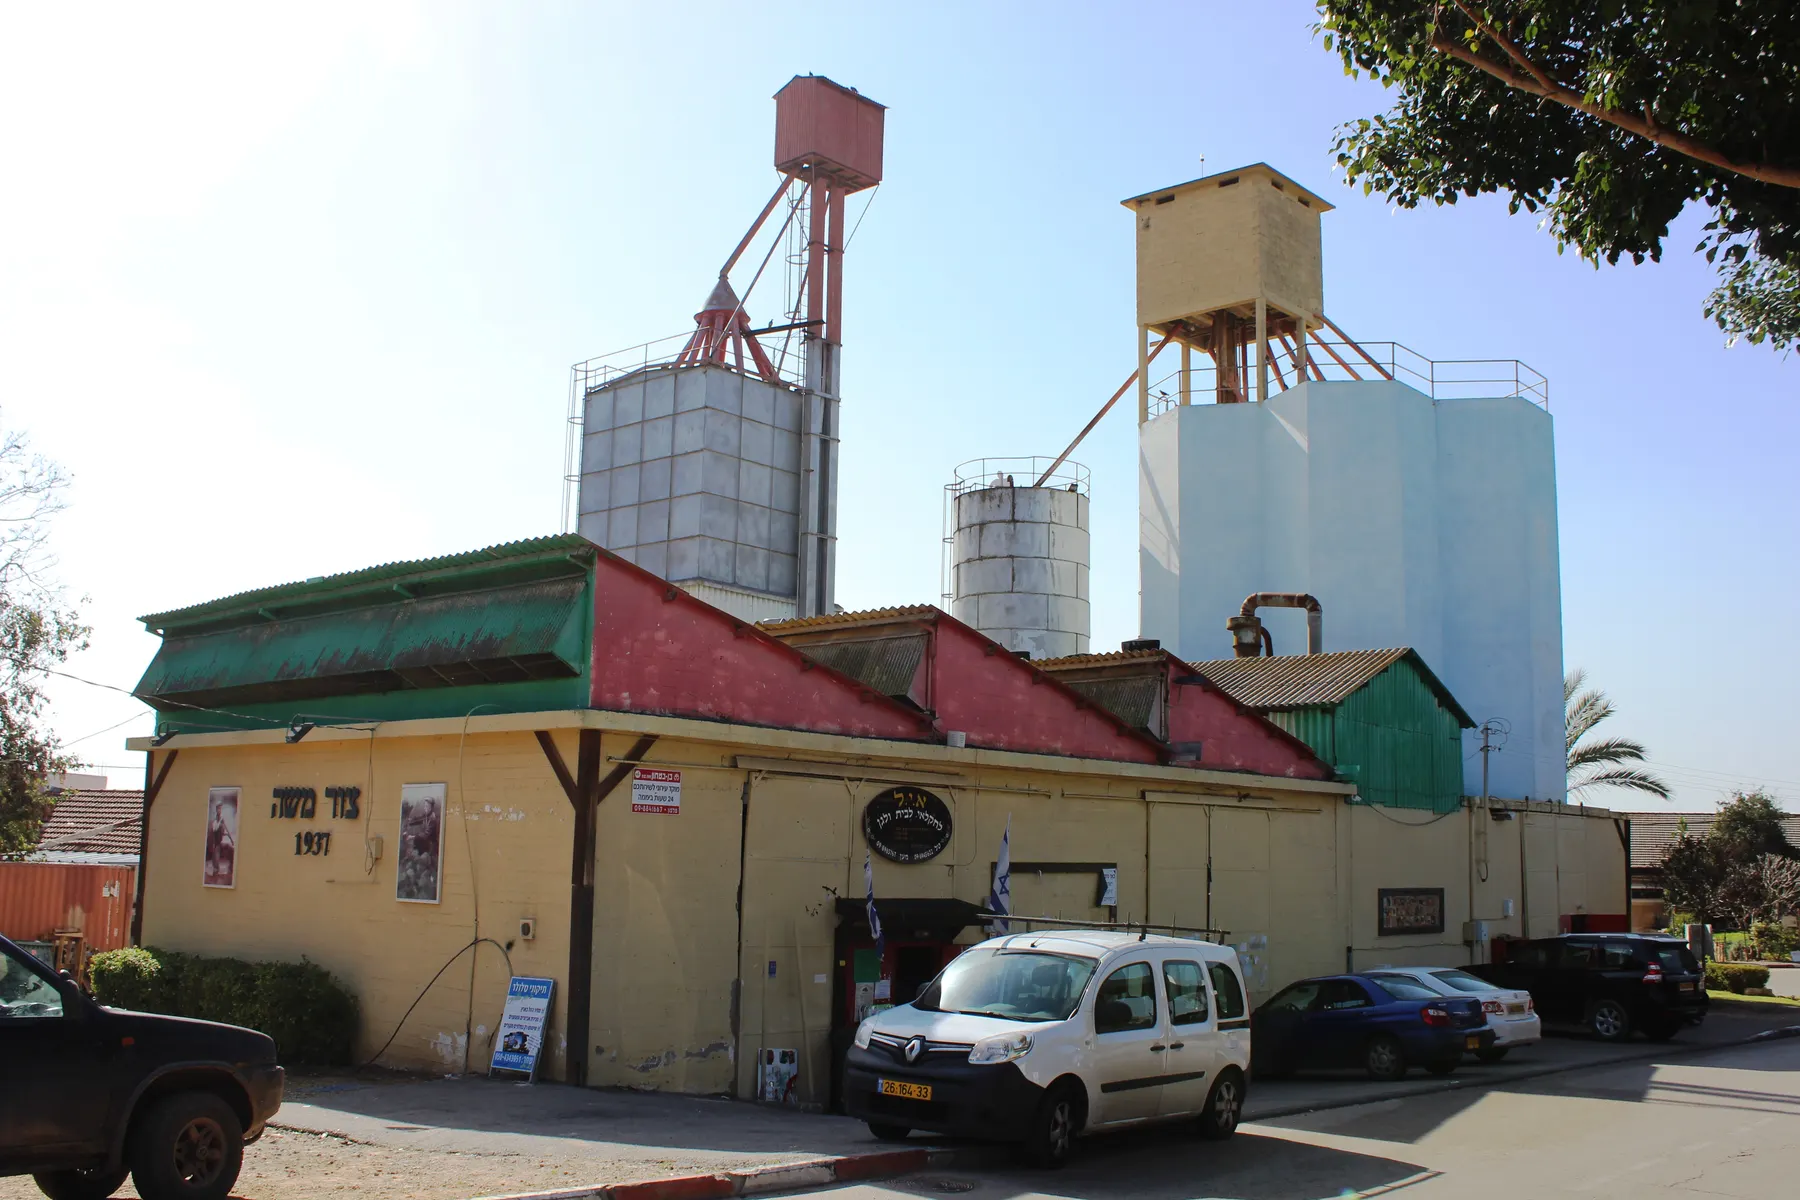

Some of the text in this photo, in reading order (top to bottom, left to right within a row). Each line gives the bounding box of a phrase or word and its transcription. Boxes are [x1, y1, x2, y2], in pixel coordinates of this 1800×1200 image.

[270, 786, 317, 819] משה
[876, 812, 892, 830] ולגן
[896, 807, 914, 820] לבית
[294, 831, 331, 856] 1937
[512, 981, 548, 996] תיקוני סלולר
